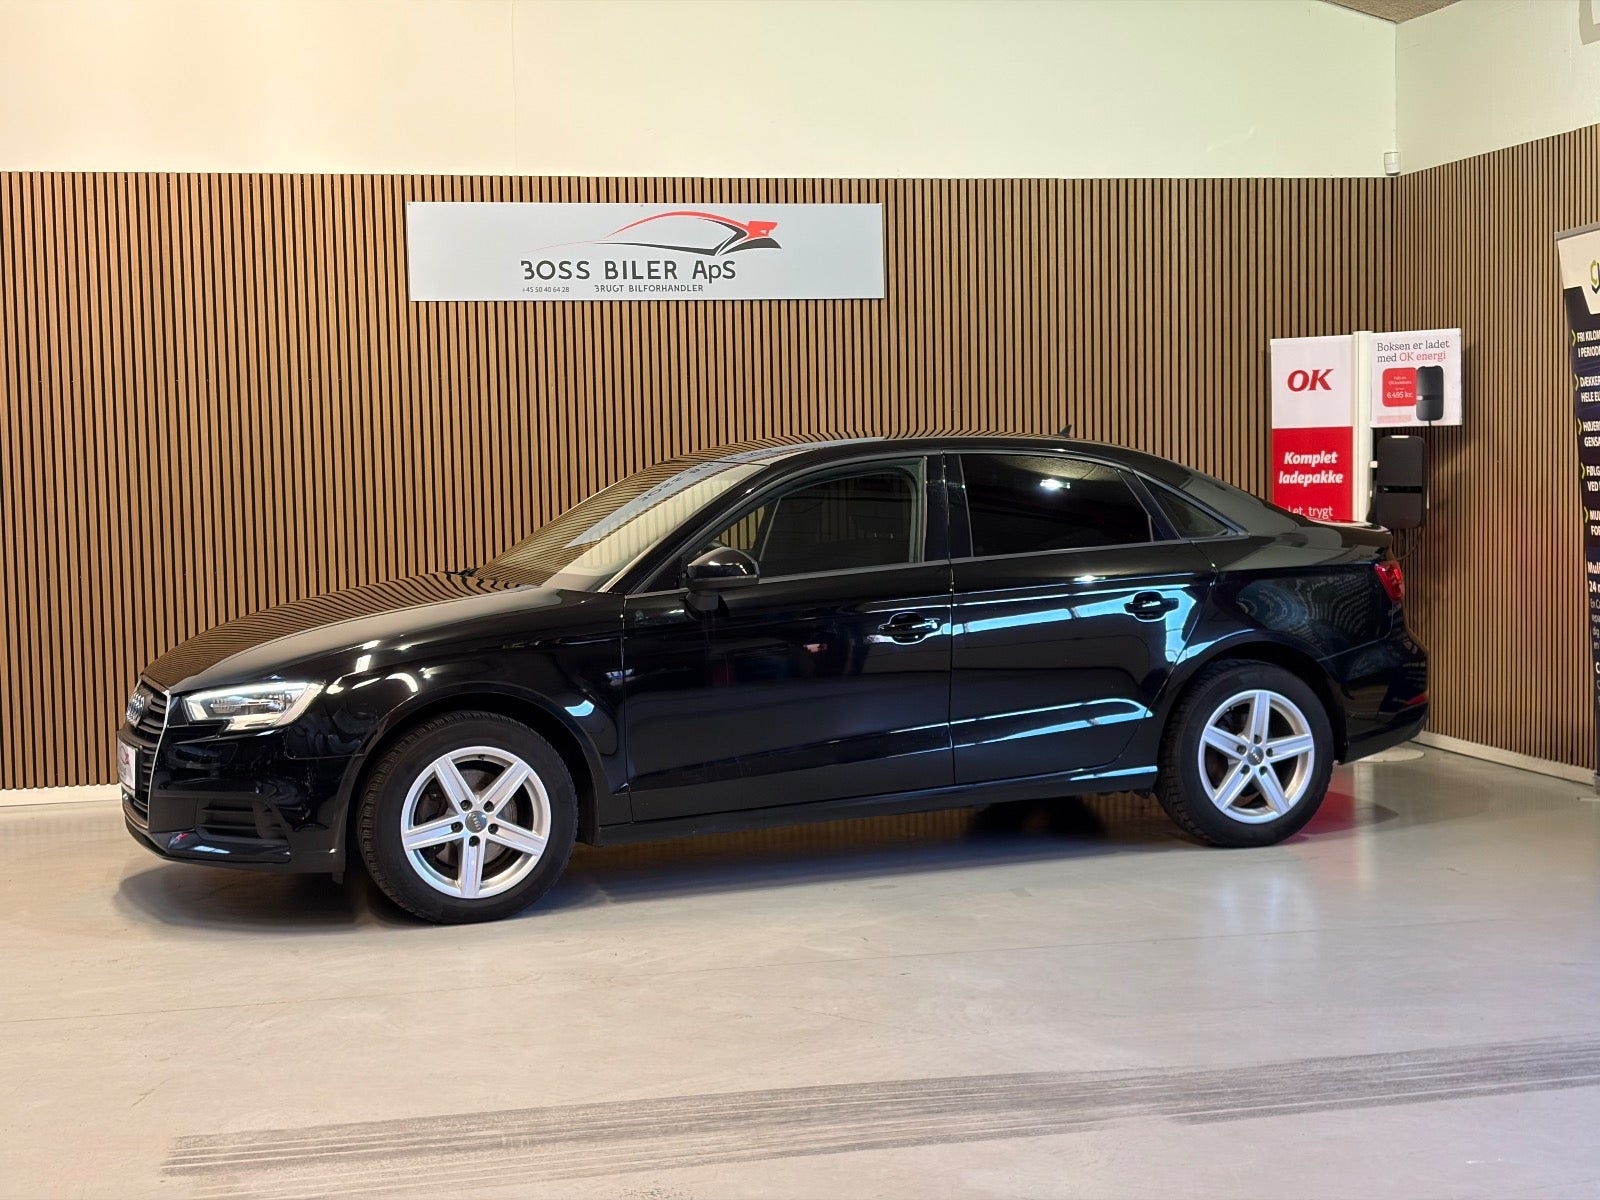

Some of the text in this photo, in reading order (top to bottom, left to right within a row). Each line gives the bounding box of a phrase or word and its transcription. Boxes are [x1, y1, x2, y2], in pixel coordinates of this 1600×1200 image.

[605, 260, 678, 279] BILER
[692, 260, 736, 284] ApS
[629, 284, 704, 292] BILFORHANDLER
[1377, 342, 1411, 352] Boksen
[1425, 339, 1450, 349] ladet
[1377, 350, 1446, 363] med OK energi
[1287, 368, 1334, 392] OK
[1284, 450, 1338, 468] Komplet
[1279, 470, 1344, 487] ladepakke
[1308, 505, 1334, 519] trygt
[1589, 580, 1597, 593] 24
